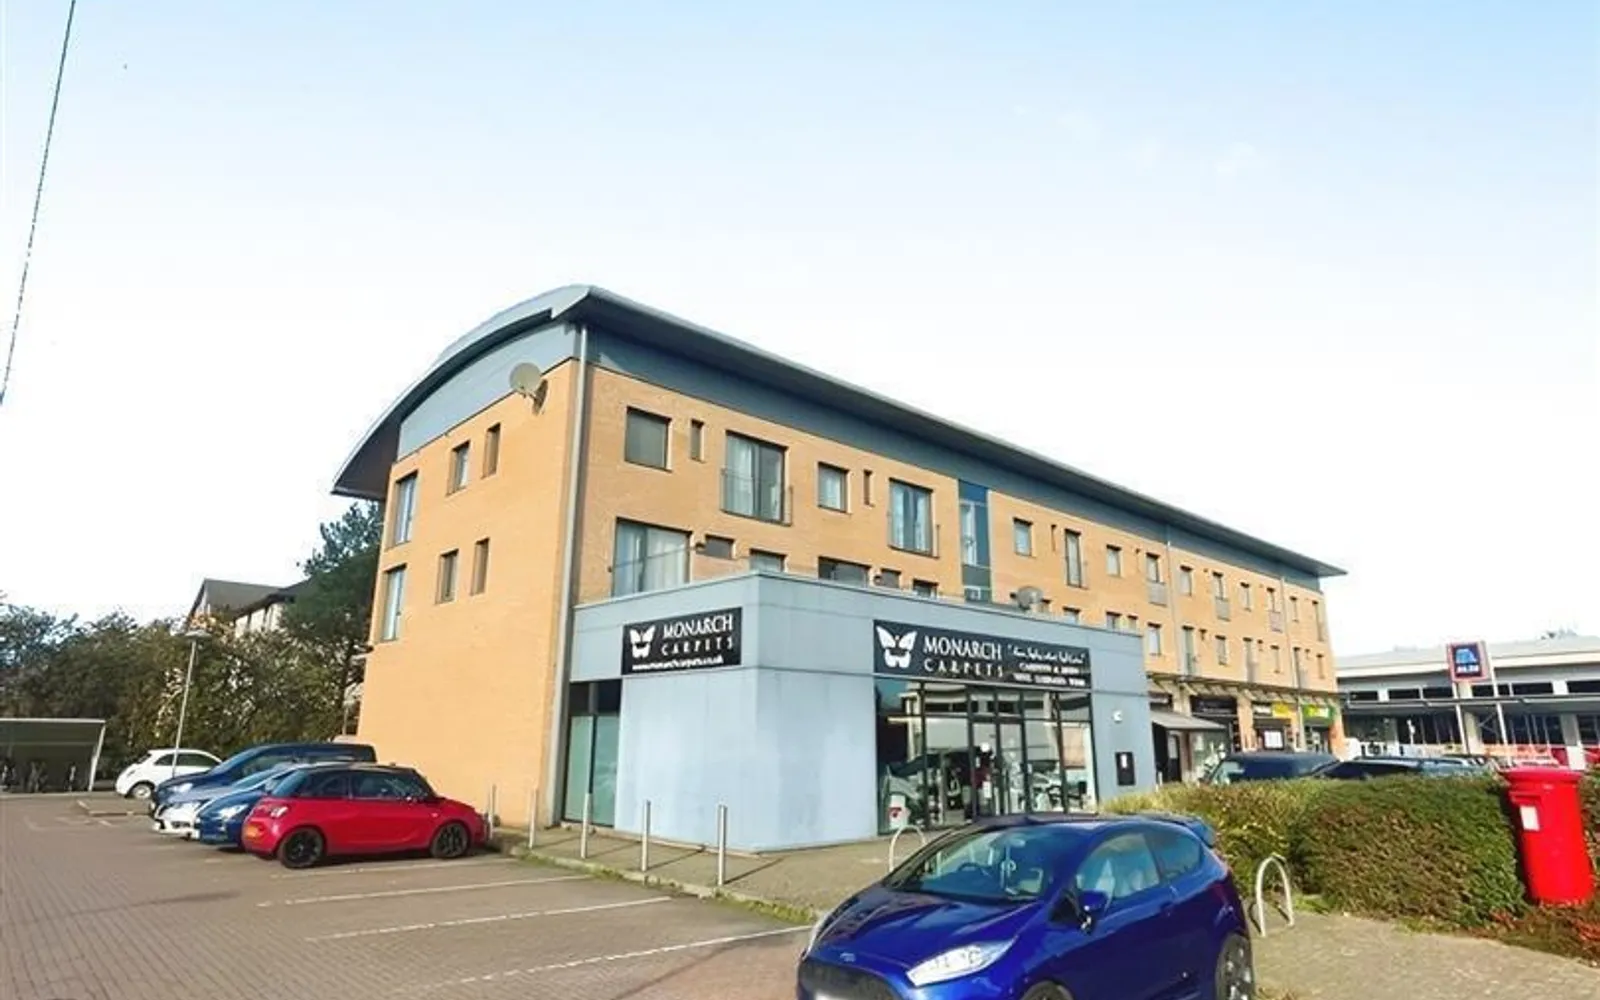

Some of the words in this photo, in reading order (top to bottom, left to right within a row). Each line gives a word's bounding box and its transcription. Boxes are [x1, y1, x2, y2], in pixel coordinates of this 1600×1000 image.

[663, 613, 733, 639] MONARCH
[661, 636, 733, 656] CARPETS
[923, 635, 1002, 660] MONARCH
[923, 658, 1003, 678] CARPETS
